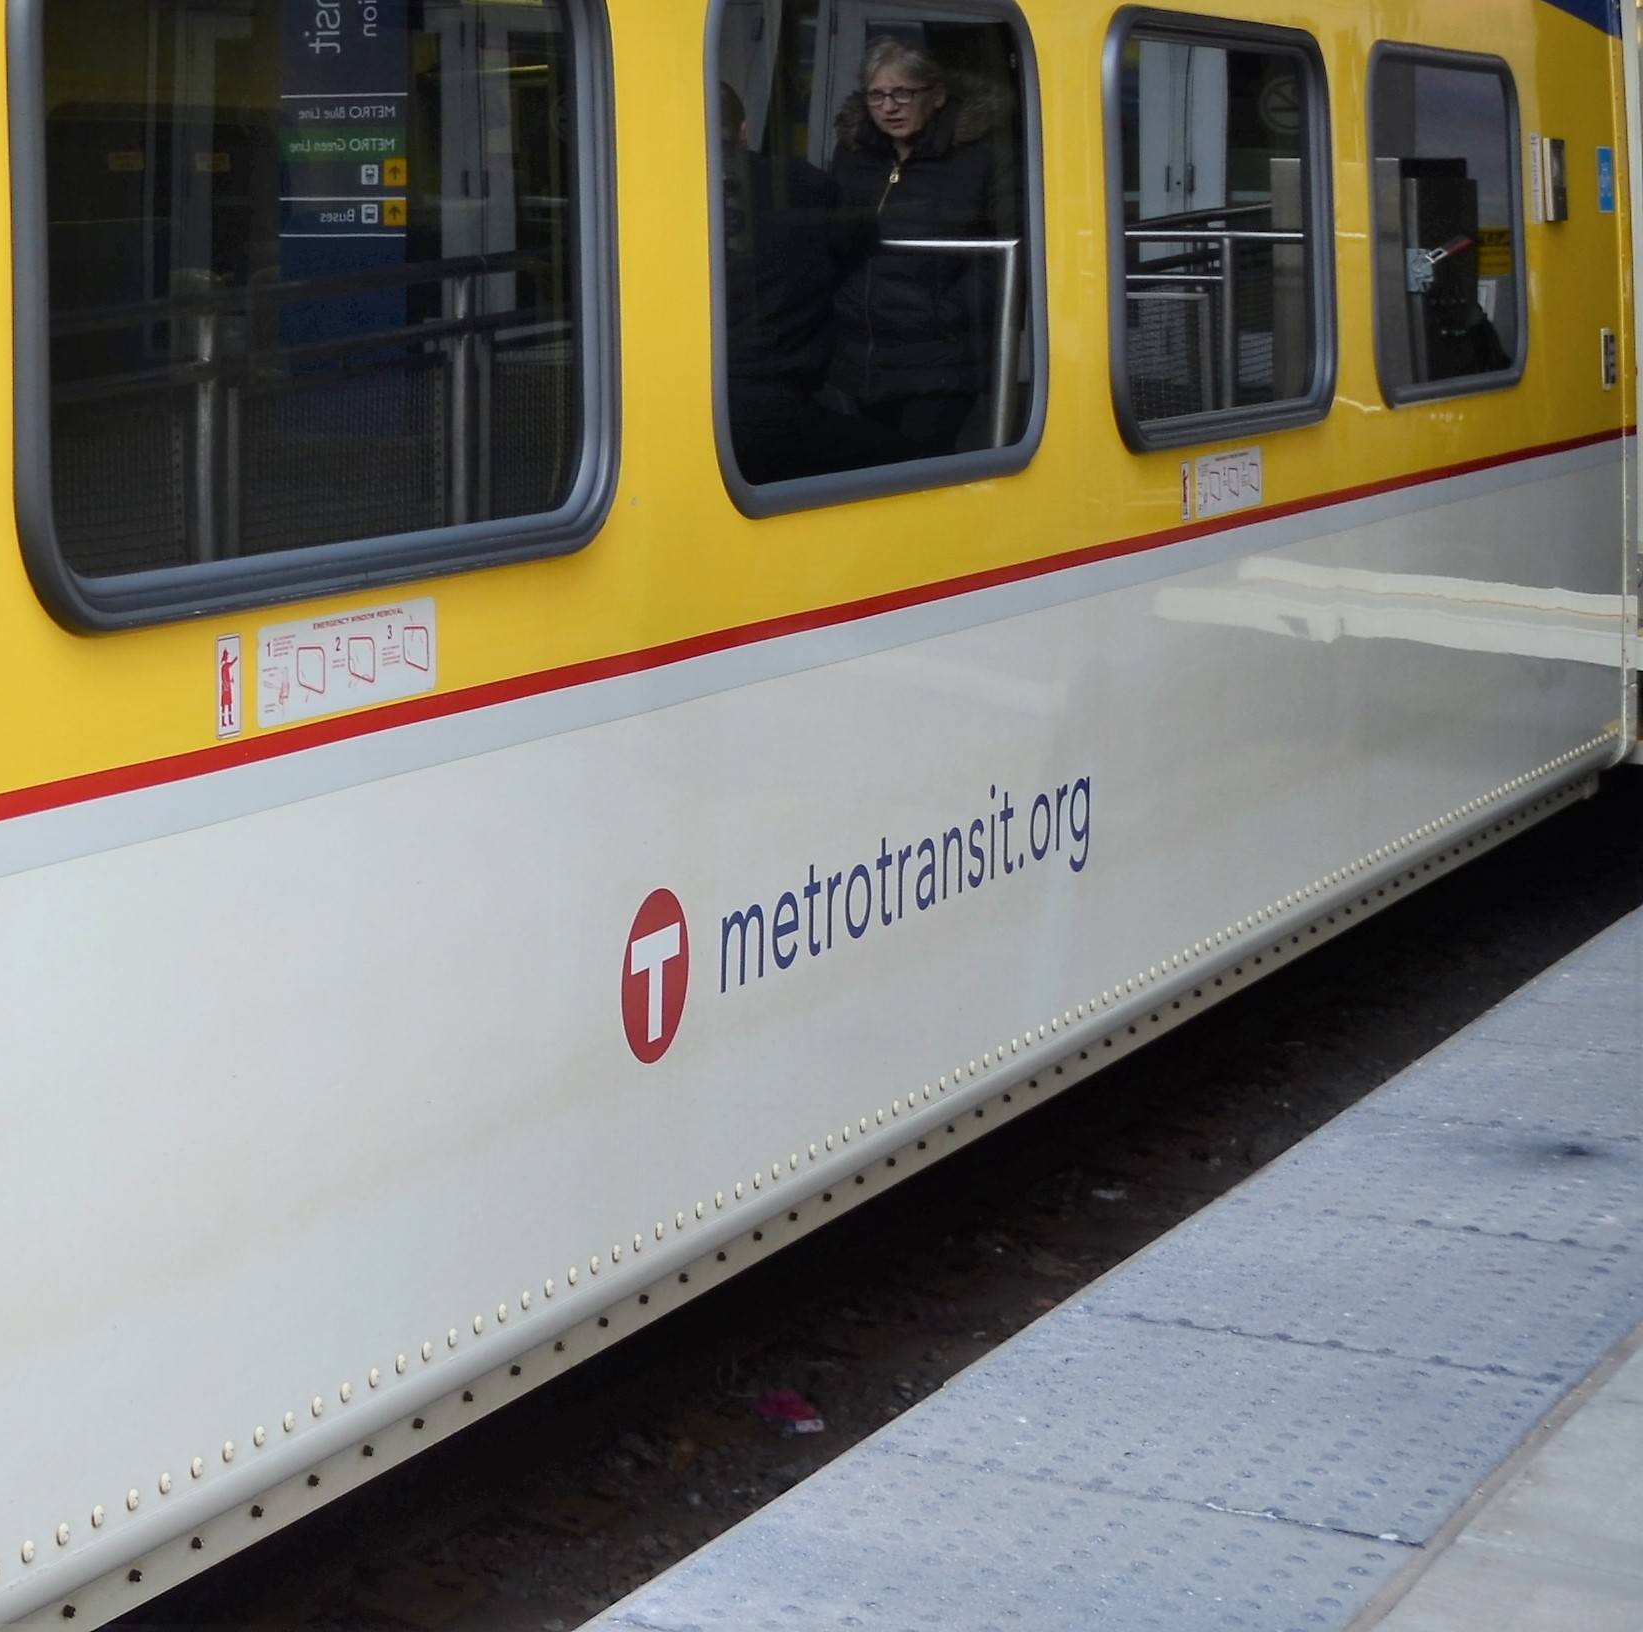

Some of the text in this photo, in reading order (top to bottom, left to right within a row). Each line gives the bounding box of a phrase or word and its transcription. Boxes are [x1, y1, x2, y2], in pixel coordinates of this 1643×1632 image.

[313, 617, 350, 631] EMERGENCY
[387, 624, 393, 640] 3
[335, 636, 341, 652] 2
[720, 776, 1091, 994] metrotransit.org
